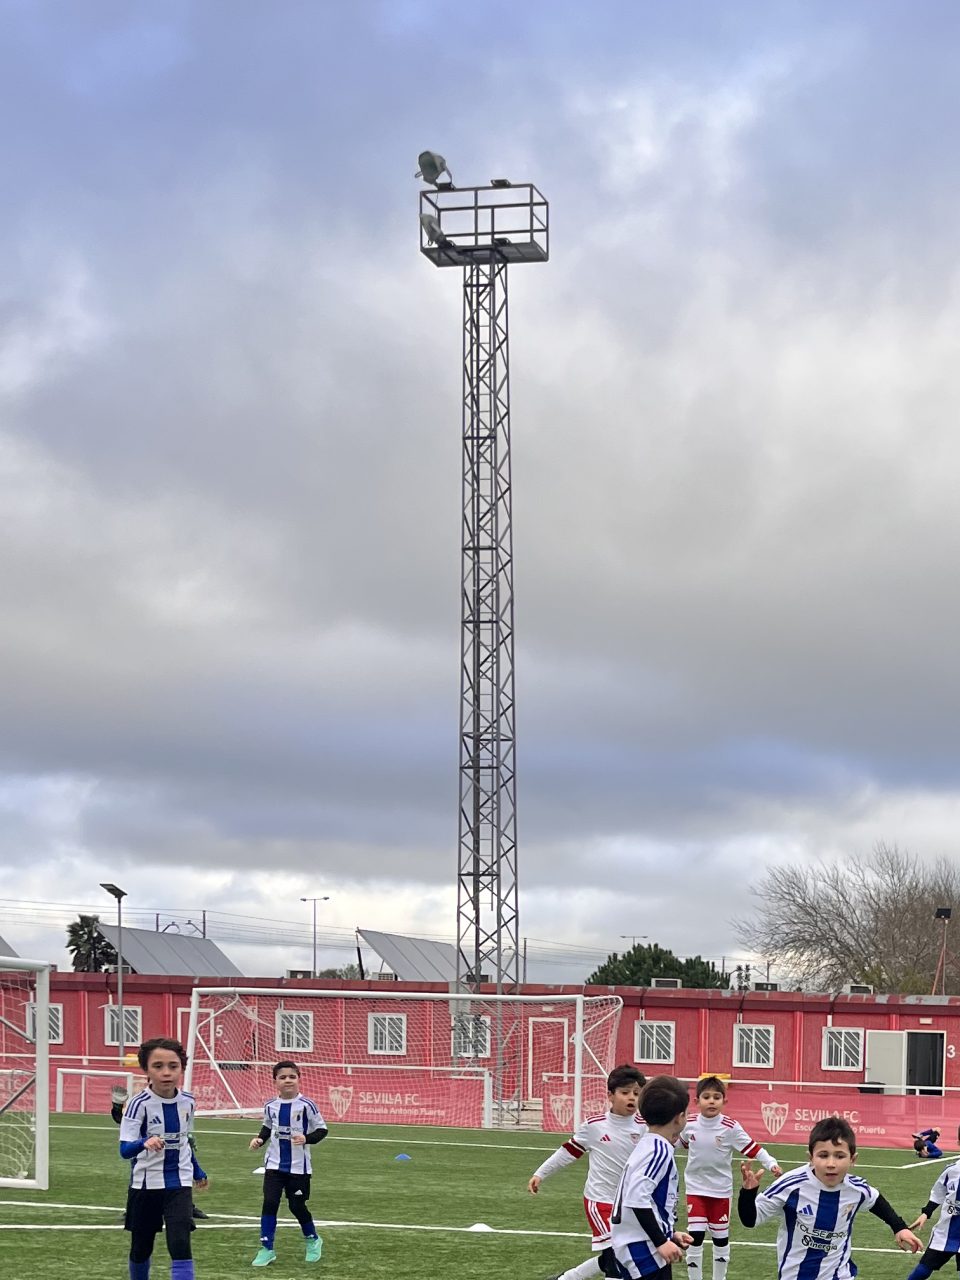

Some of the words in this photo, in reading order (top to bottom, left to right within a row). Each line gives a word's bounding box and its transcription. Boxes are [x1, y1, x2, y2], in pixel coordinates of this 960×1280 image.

[215, 1025, 224, 1037] 5
[946, 1044, 956, 1059] 3
[359, 1091, 403, 1105] SEVILLA
[404, 1094, 420, 1106] FC
[359, 1105, 388, 1114] Escuela
[389, 1107, 419, 1115] Antonio
[843, 1110, 859, 1123] FC
[859, 1126, 886, 1135] Puerta
